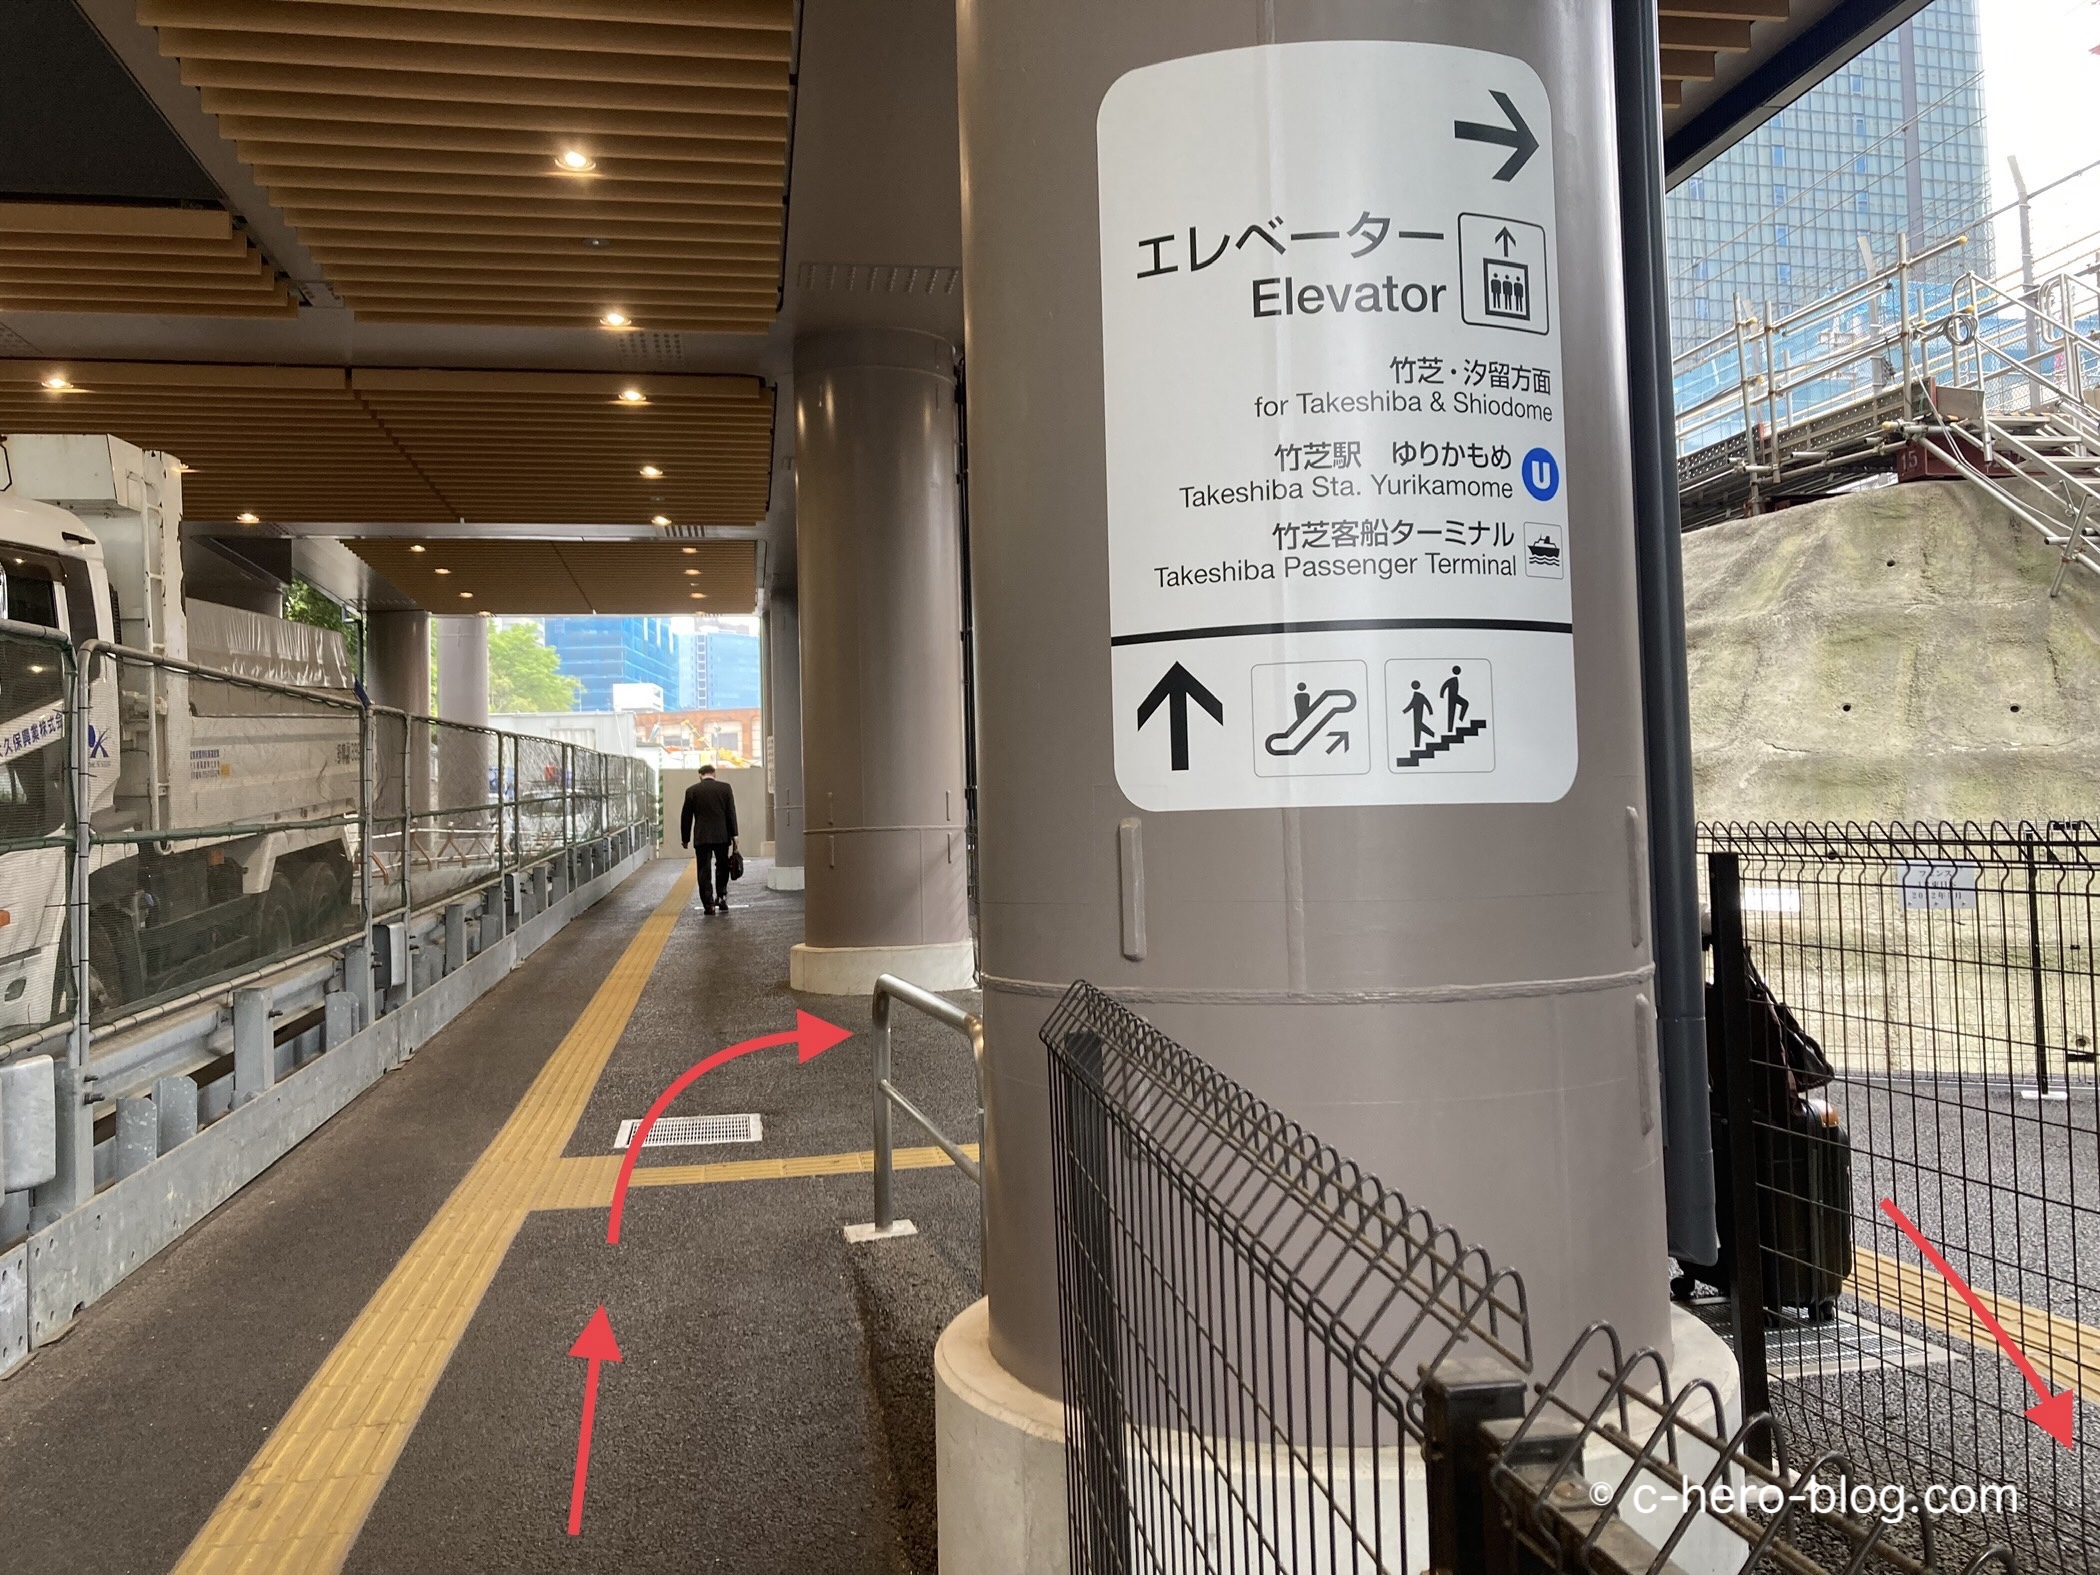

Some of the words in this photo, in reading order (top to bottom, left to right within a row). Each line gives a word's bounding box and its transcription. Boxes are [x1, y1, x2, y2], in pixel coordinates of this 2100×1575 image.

[1137, 211, 1445, 279] エレベーター
[1252, 275, 1447, 319] Elevator
[1389, 356, 1552, 396] 竹芝・汐留方面
[1254, 396, 1289, 418] for
[1296, 390, 1423, 415] Takeshiba
[1430, 391, 1447, 412] &
[1454, 391, 1553, 423] Shiodome
[1274, 441, 1362, 472] 竹芝駅
[1392, 440, 1513, 470] ゆりかもめ
[1179, 476, 1304, 508] Takeshiba
[1312, 476, 1362, 498] Sta.
[1371, 473, 1514, 499] Yurikamome
[1532, 460, 1551, 490] U
[1272, 519, 1515, 551] 竹芝客船ターミナル
[1154, 558, 1276, 588] Takeshiba
[1284, 555, 1419, 580] Passenger
[1425, 552, 1517, 577] Terminal
